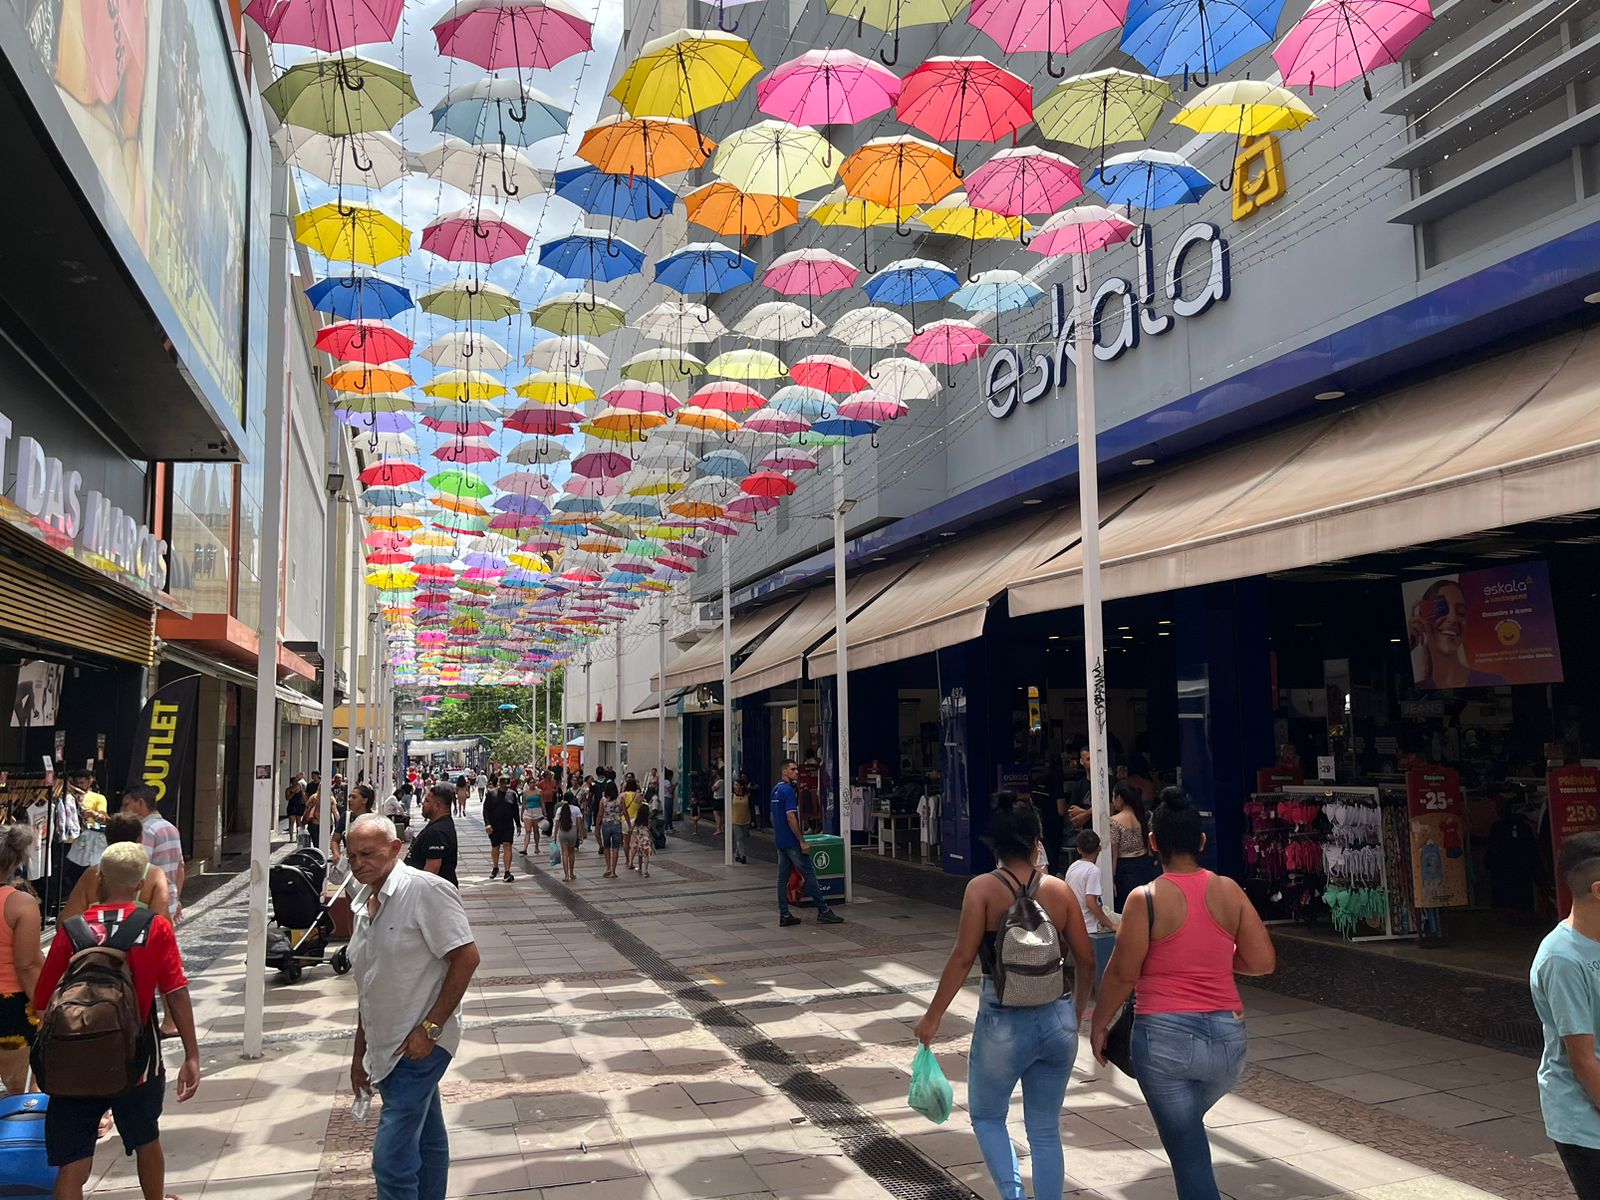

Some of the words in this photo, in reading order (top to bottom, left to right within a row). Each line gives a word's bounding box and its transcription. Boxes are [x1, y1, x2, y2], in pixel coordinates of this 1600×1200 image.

[985, 222, 1231, 419] eskala
[15, 436, 83, 539] DAS
[82, 490, 168, 590] MARCAS
[1483, 579, 1527, 596] eskala
[1404, 703, 1442, 715] JEANS
[142, 700, 179, 802] OUTLET
[1425, 791, 1448, 810] 25
